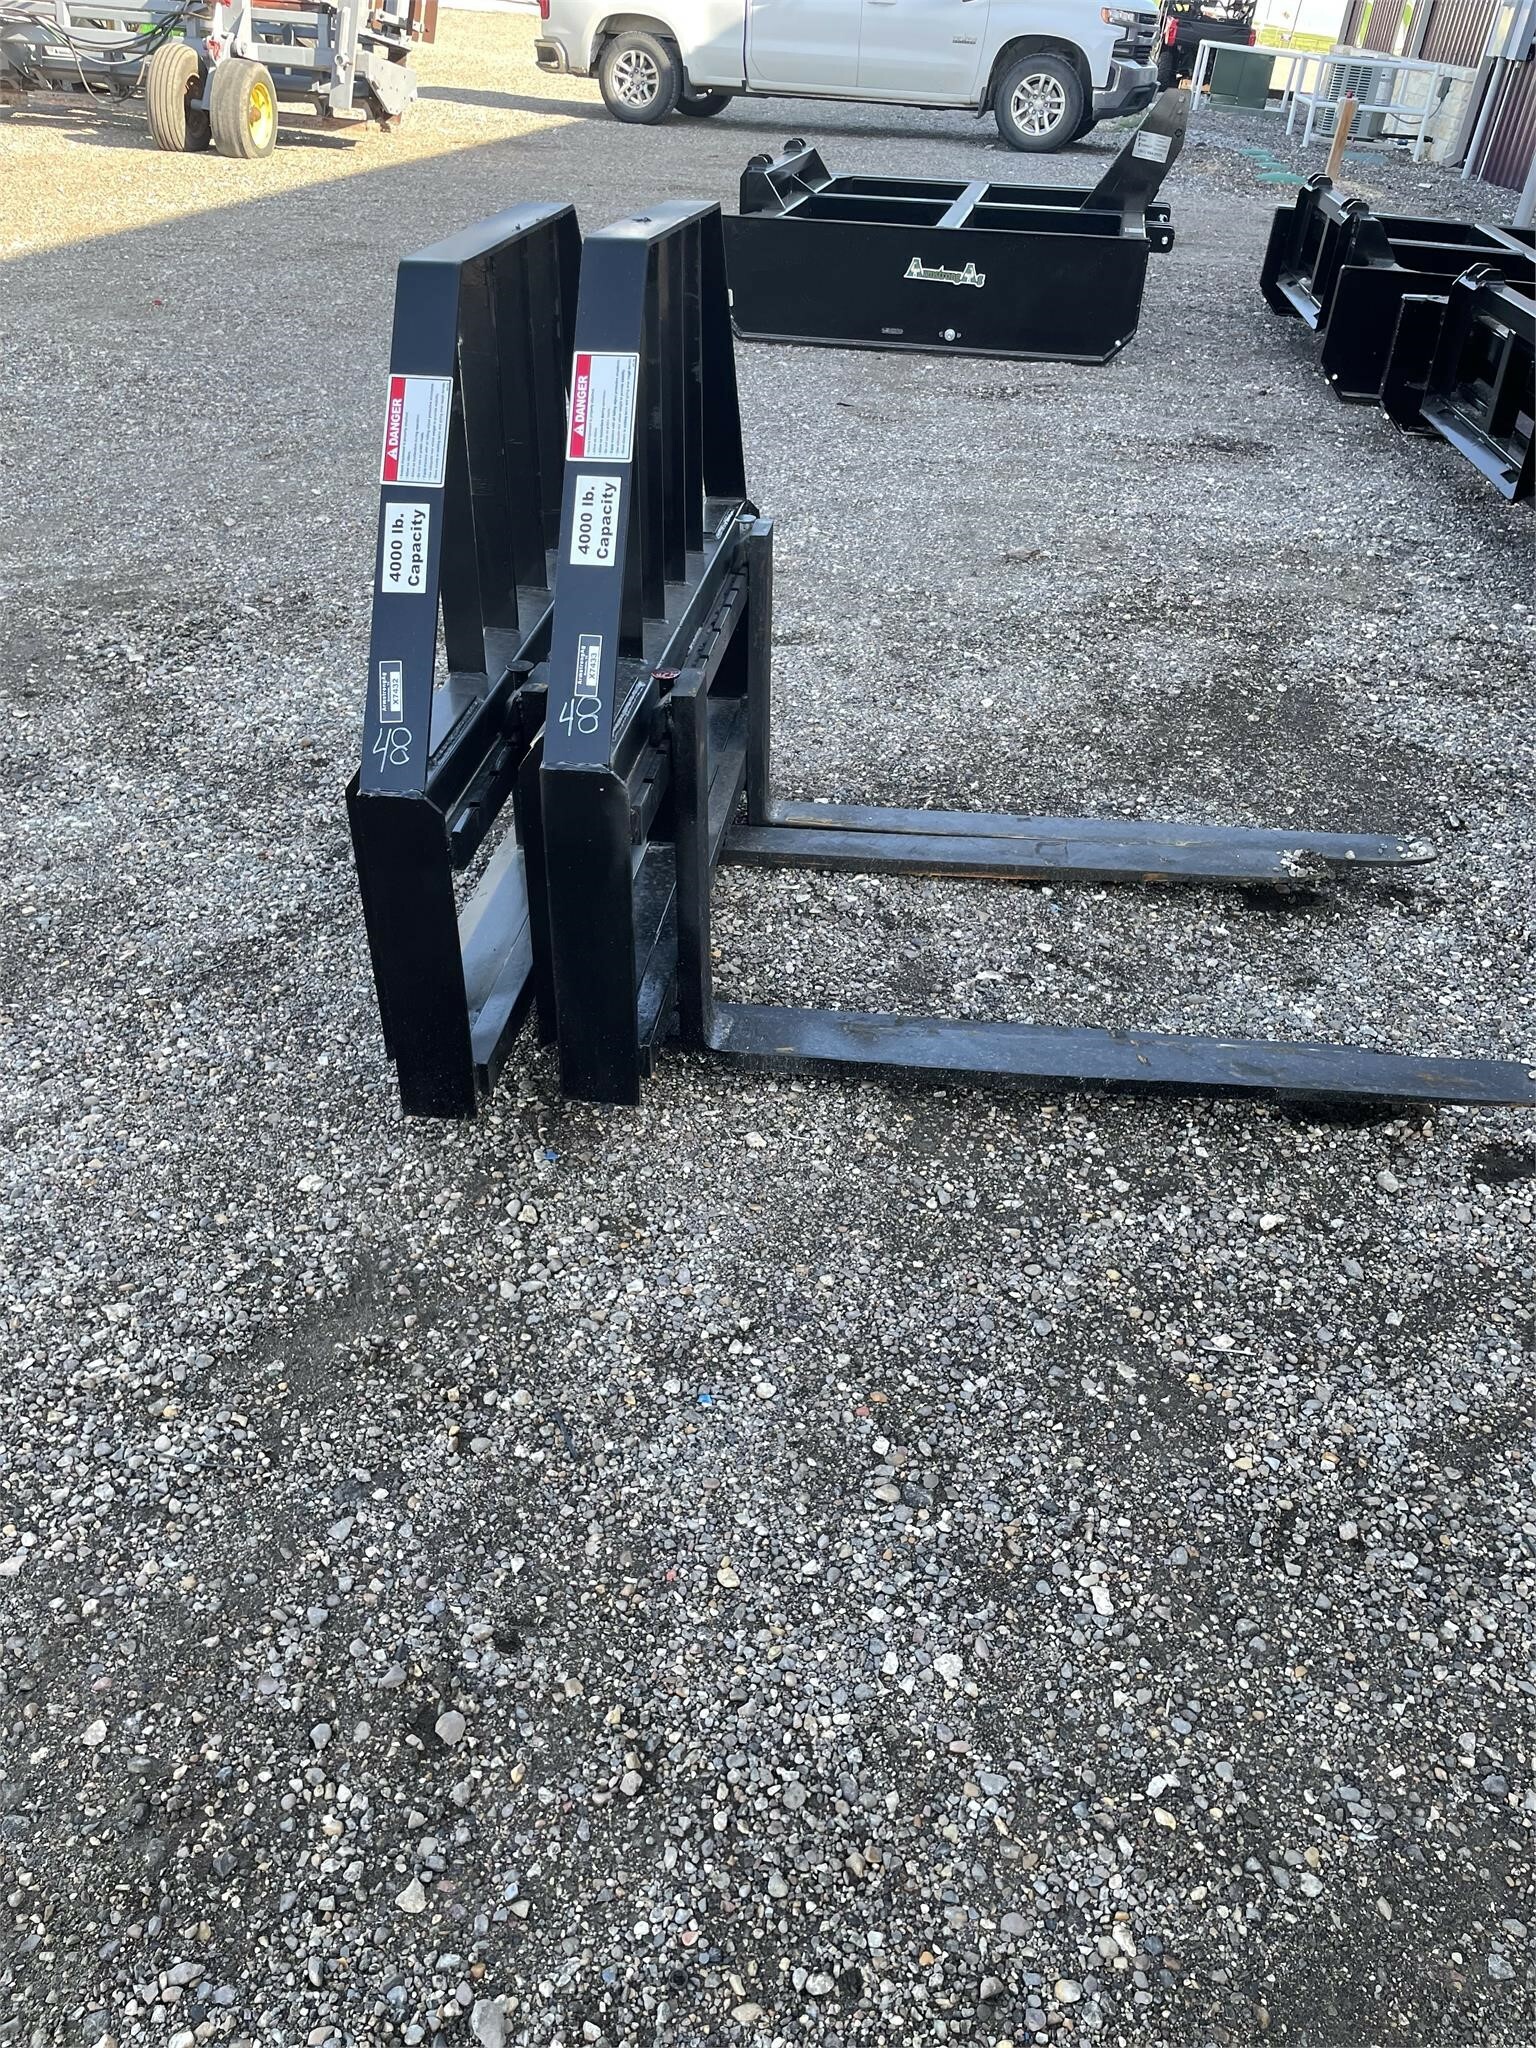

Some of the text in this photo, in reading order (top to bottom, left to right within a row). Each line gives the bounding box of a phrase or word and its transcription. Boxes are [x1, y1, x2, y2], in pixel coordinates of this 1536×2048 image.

[389, 398, 402, 446] DANGER
[575, 376, 588, 422] DANGER
[389, 513, 404, 582] 4000 lb.
[408, 509, 426, 587] Capacity
[578, 486, 596, 555] 4000 lb.
[597, 482, 617, 559] Capacity
[588, 652, 597, 680] X7433
